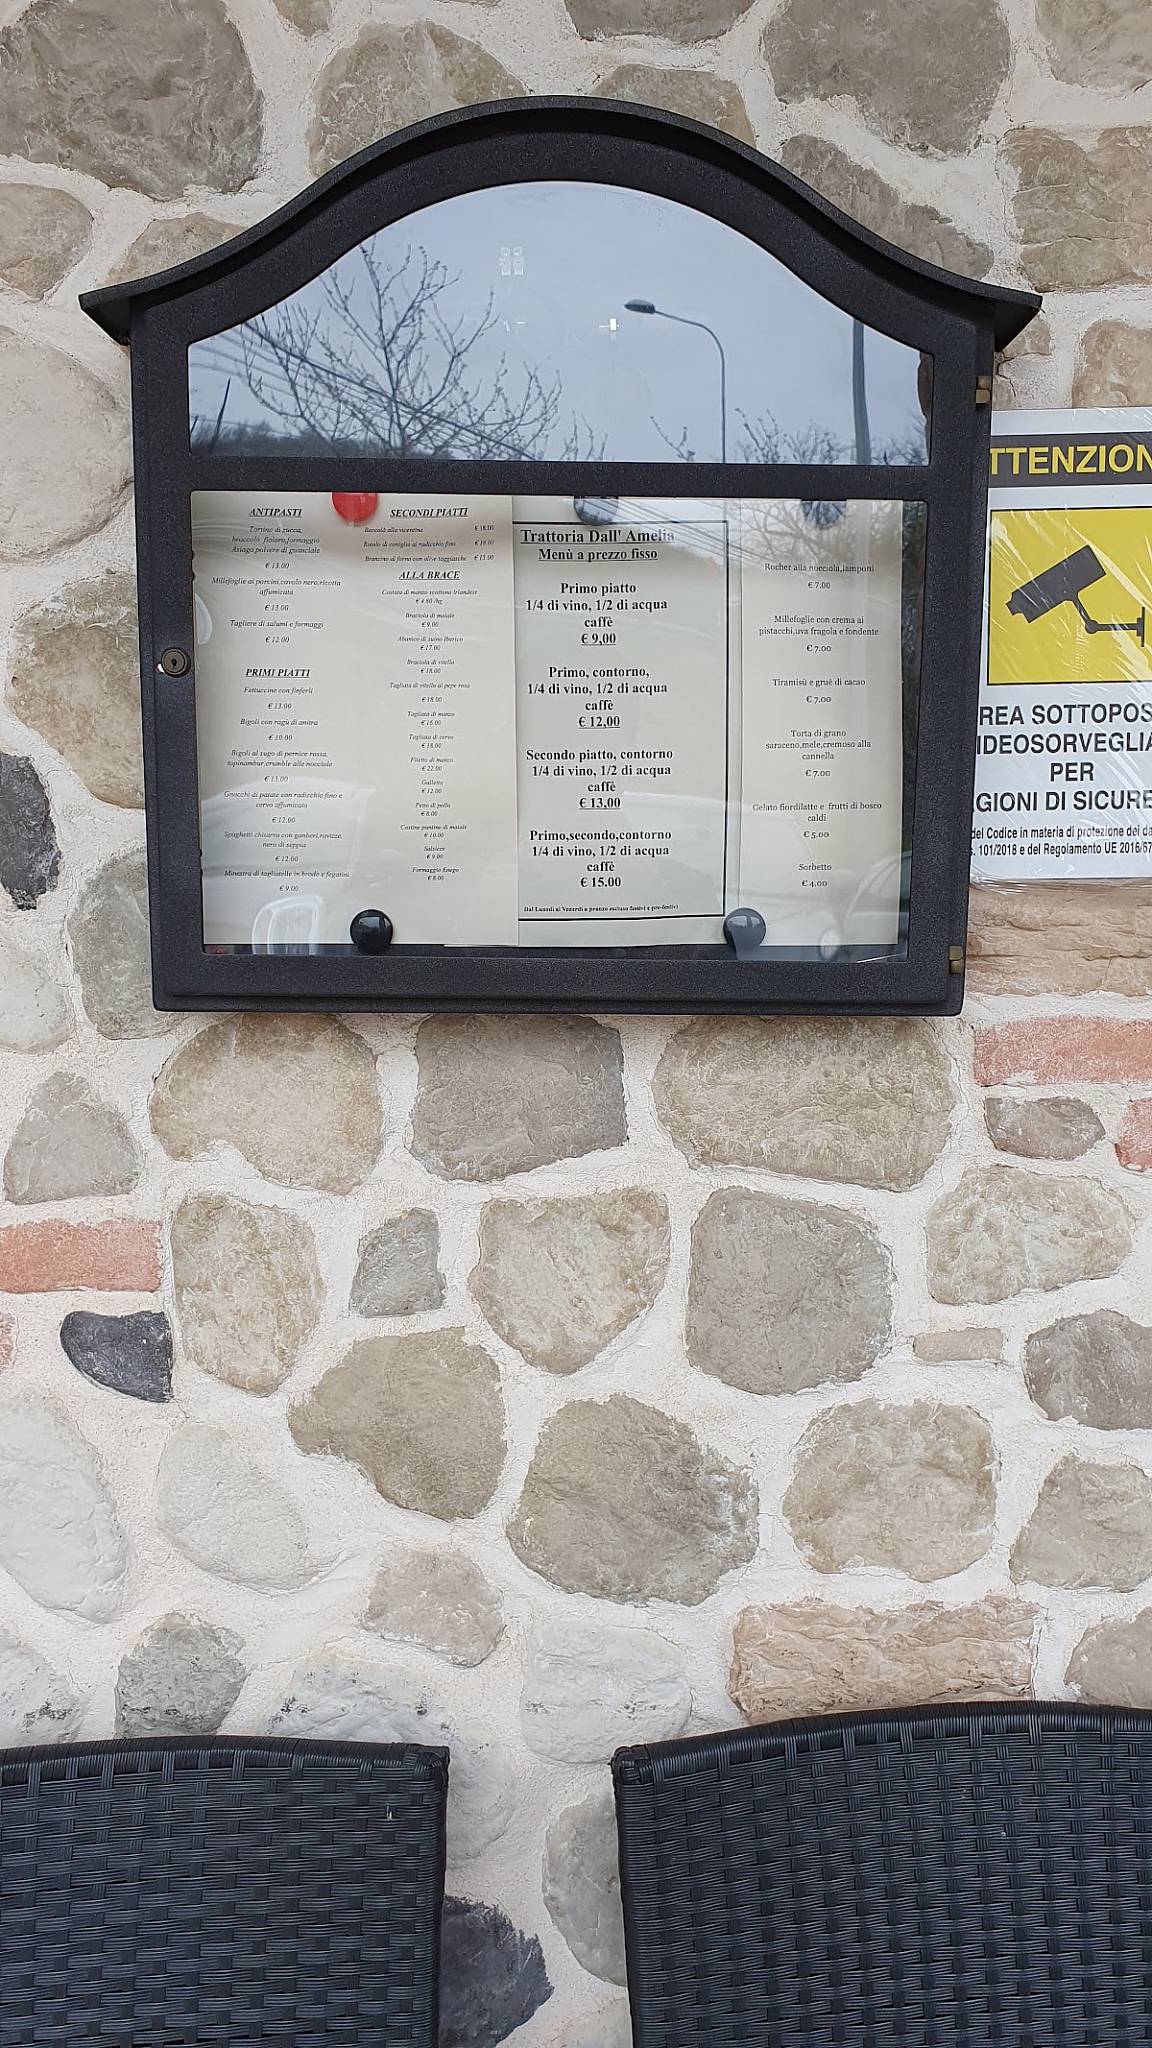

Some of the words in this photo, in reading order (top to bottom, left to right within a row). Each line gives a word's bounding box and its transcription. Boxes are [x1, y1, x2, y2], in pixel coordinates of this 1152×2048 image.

[249, 508, 302, 517] ANTIPASTI
[390, 508, 435, 518] SECONDI
[436, 507, 468, 517] PIATTI
[274, 525, 280, 533] di
[520, 528, 584, 543] Trattoria
[589, 528, 621, 543] Dall'
[626, 528, 674, 542] Amelia
[539, 548, 572, 559] Menù
[578, 550, 584, 559] a
[588, 550, 627, 562] prezzo
[631, 547, 658, 559] fisso
[765, 562, 791, 571] Rocher
[793, 563, 806, 571] alla
[399, 570, 424, 579] ALLA
[427, 570, 460, 579] BRACE
[560, 582, 597, 594] Primo
[602, 582, 636, 596] piatto
[815, 581, 830, 589] 7.00
[526, 599, 543, 611] 1/4
[548, 599, 559, 611] di
[563, 599, 592, 612] vino,
[596, 599, 612, 611] 1/2
[617, 598, 628, 610] di
[632, 600, 667, 612] acqua
[230, 619, 256, 628] Tagliere
[294, 620, 323, 629] formaggi
[584, 616, 613, 628] caffè
[774, 615, 814, 624] Millefoglie
[857, 615, 864, 623] ai
[811, 627, 836, 636] fragola
[846, 627, 879, 635] fondente
[581, 633, 588, 643] €
[592, 632, 616, 644] 9,00
[807, 644, 812, 652] €
[814, 645, 831, 653] 7.00
[246, 668, 275, 677] PRIMI
[278, 668, 310, 677] PIATTI
[549, 666, 589, 678] Primo,
[593, 666, 649, 678] contorno,
[773, 678, 807, 686] Tiramisù
[816, 678, 833, 687] gruè
[835, 677, 842, 686] di
[244, 686, 277, 694] Fettuccine
[528, 683, 545, 694] 1/4
[549, 683, 559, 694] di
[564, 683, 592, 695] vino,
[597, 682, 613, 694] 1/2
[618, 682, 628, 693] di
[633, 684, 667, 695] acqua
[814, 695, 831, 704] 7.00
[585, 699, 614, 711] caffè
[1032, 703, 1152, 724] SOTTOPOS
[240, 718, 259, 726] Bigoli
[274, 718, 289, 726] ragù
[579, 716, 586, 728] €
[590, 715, 620, 728] 12,00
[791, 729, 811, 737] Torta
[814, 728, 821, 737] di
[824, 730, 846, 738] grano
[858, 739, 871, 747] alla
[527, 749, 575, 760] Secondo
[580, 749, 616, 762] piatto,
[621, 749, 673, 759] contorno
[802, 751, 834, 760] cannella
[532, 765, 549, 776] 1/4
[553, 764, 564, 776] di
[568, 765, 596, 777] vino,
[601, 764, 617, 775] 1/2
[621, 764, 633, 775] di
[636, 766, 671, 777] acqua
[813, 770, 830, 778] 7.00
[1051, 762, 1094, 781] PER
[588, 780, 616, 792] caffè
[580, 797, 586, 807] €
[753, 803, 777, 811] Gelato
[779, 802, 818, 811] fiordilatte
[828, 801, 848, 810] frutti
[850, 801, 858, 809] di
[860, 801, 882, 809] bosco
[1046, 792, 1065, 811] DI
[808, 813, 826, 821] caldi
[530, 829, 671, 841] Primo,secondo,contorno
[811, 831, 829, 839] 5.00
[987, 827, 1017, 838] Codice
[1020, 827, 1028, 838] in
[1031, 827, 1063, 838] materia
[1066, 826, 1074, 837] di
[1077, 826, 1123, 839] protezione
[1127, 825, 1140, 836] dei
[532, 845, 549, 856] 1/4
[553, 845, 564, 856] di
[567, 846, 595, 857] vino,
[600, 844, 616, 856] 1/2
[620, 844, 631, 855] di
[635, 846, 669, 858] acqua
[979, 845, 1017, 856] 101/2018
[1028, 844, 1040, 854] del
[1044, 843, 1101, 857] Regolamento
[1104, 842, 1116, 853] UE
[587, 860, 615, 872] caffè
[799, 862, 832, 871] Sorbetto
[580, 876, 588, 887] €
[592, 876, 621, 887] 15.00
[809, 880, 827, 888] 4.00
